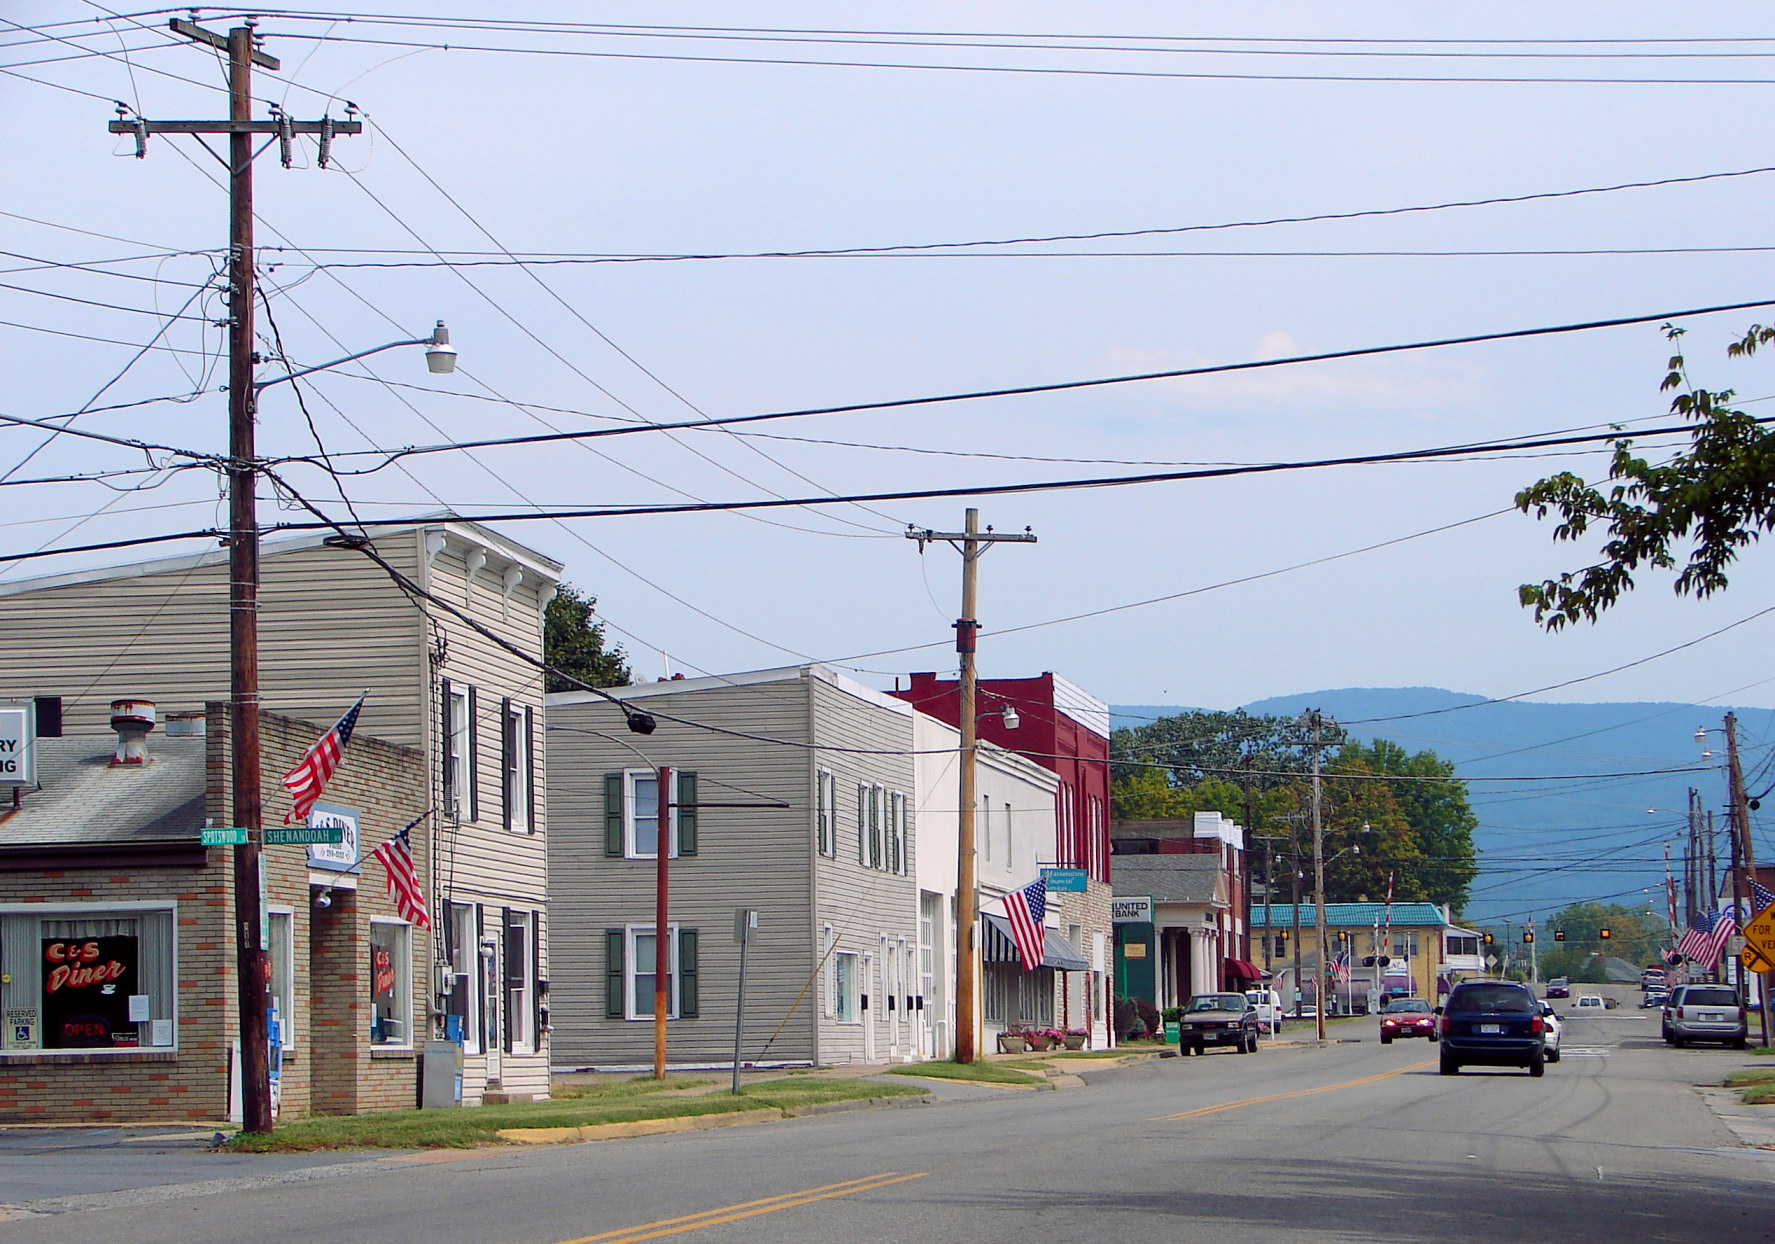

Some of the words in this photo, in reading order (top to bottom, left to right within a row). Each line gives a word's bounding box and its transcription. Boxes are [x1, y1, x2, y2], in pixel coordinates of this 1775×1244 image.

[202, 830, 237, 844] SPOTSWOOD
[267, 830, 330, 843] SHENANDOAH
[1115, 902, 1148, 910] UNITED
[1753, 925, 1771, 935] FOR
[1762, 939, 1775, 950] VE
[1744, 952, 1752, 960] R
[47, 960, 126, 994] Diner
[6, 1009, 36, 1018] RESERVED
[9, 1018, 35, 1026] PARKING
[64, 1023, 105, 1037] OPEN
